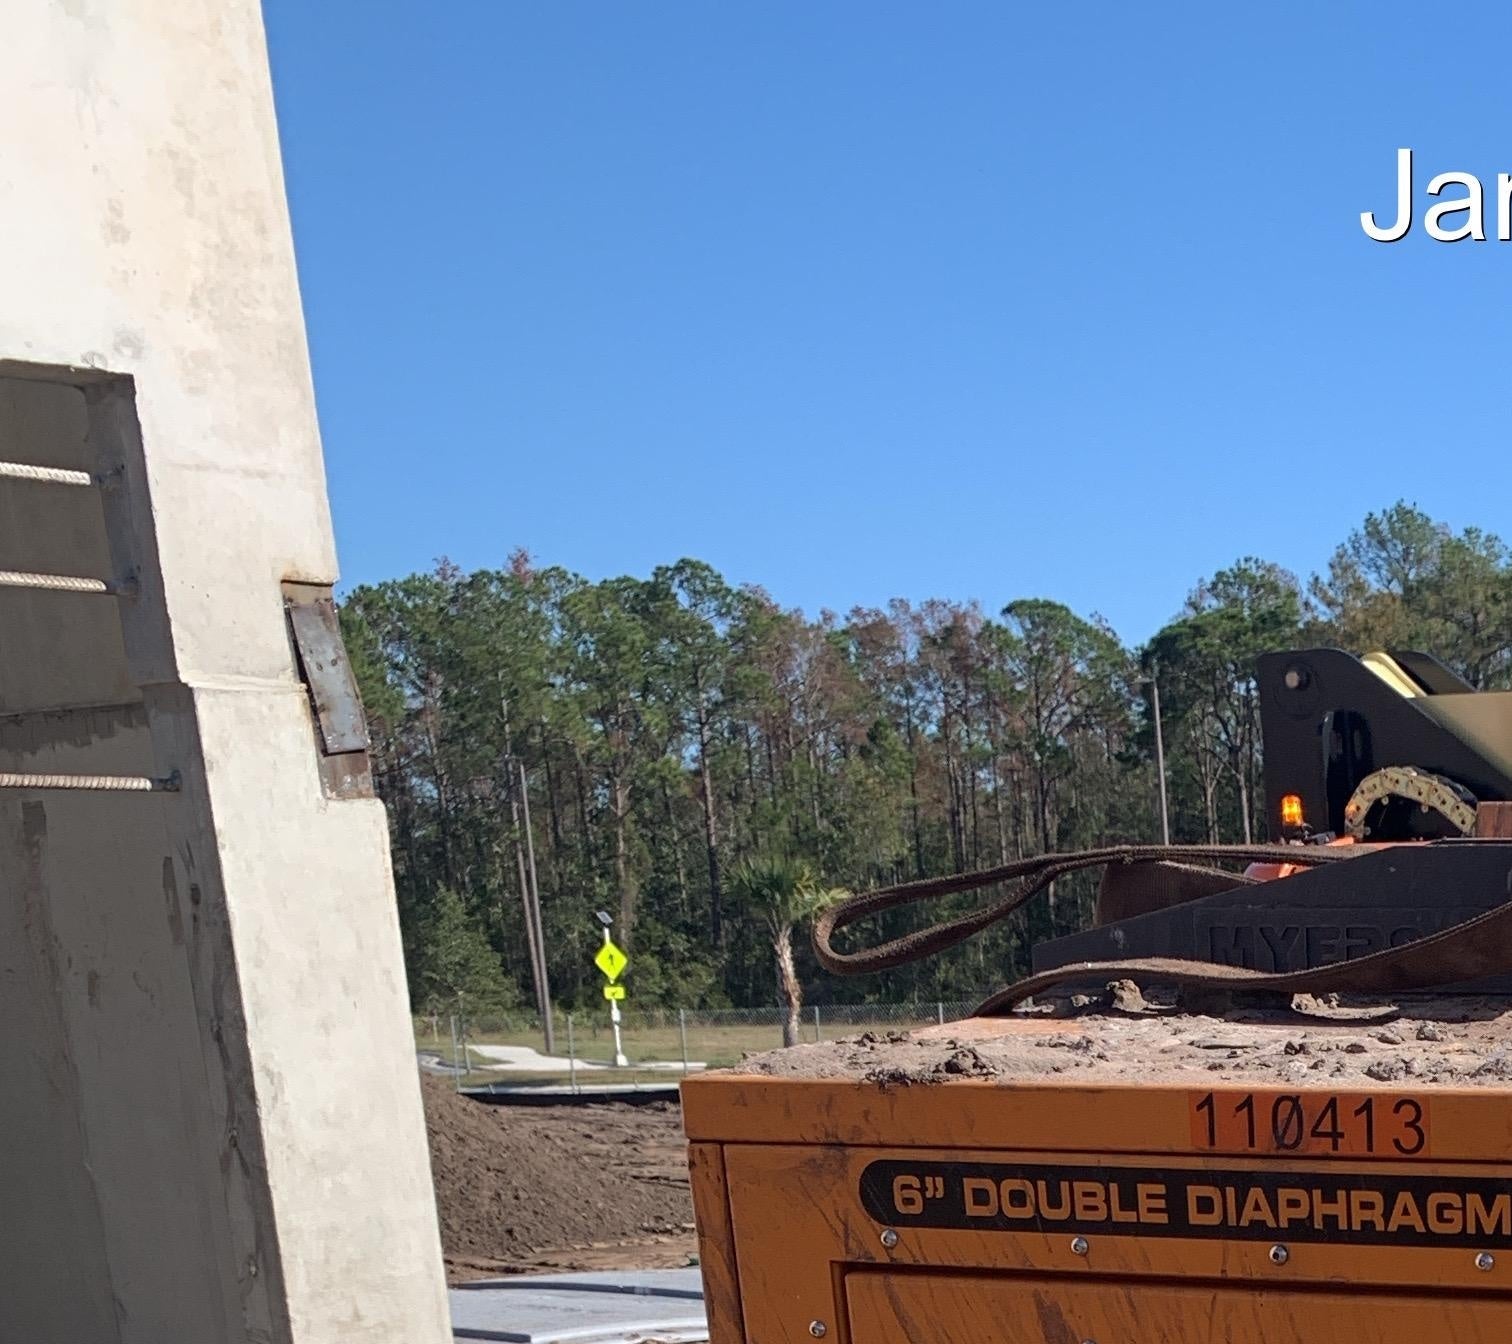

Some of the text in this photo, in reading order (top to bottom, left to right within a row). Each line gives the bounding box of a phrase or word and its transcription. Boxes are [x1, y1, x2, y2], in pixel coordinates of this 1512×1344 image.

[1194, 1094, 1427, 1156] 110413
[963, 1176, 1169, 1226] DOUBLE
[1188, 1184, 1512, 1237] DIAPHRAGM
